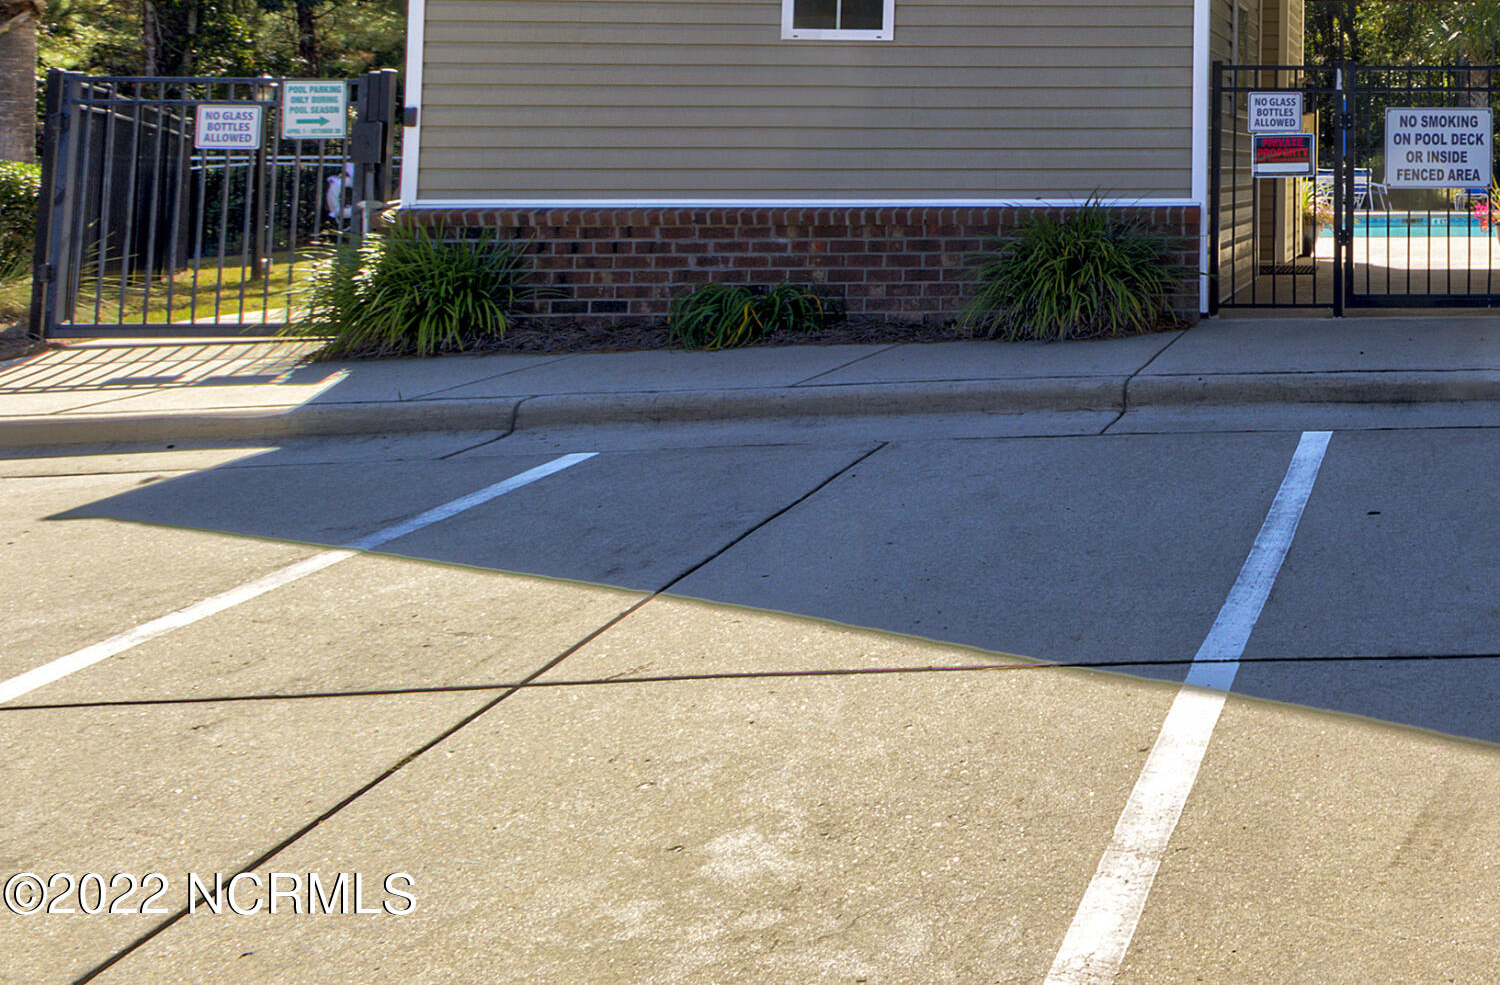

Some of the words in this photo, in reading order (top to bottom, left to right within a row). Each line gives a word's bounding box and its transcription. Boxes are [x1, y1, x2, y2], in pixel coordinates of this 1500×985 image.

[287, 85, 308, 94] POOL
[309, 85, 342, 94] PARKING
[1254, 98, 1268, 106] NO
[1269, 98, 1297, 107] GLASS
[289, 106, 308, 114] POOL
[310, 106, 340, 114] SEASON
[1256, 108, 1294, 116] BOTTLES
[205, 111, 221, 120] NO
[222, 111, 254, 121] GLASS
[1254, 118, 1296, 127] ALLOWED
[1399, 115, 1418, 128] NO
[1421, 115, 1479, 128] SMOKING
[207, 122, 251, 131] BOTTLES
[204, 133, 252, 143] ALLOWED
[1262, 138, 1304, 147] PRIVATE
[1393, 133, 1411, 146] ON
[1415, 133, 1448, 146] POOL
[1451, 133, 1485, 146] DECK
[1256, 147, 1309, 157] PROPERTY
[1406, 151, 1423, 164] OR
[1427, 151, 1468, 164] INSIDE
[1396, 169, 1445, 181] FENCED
[1447, 169, 1481, 182] AREA
